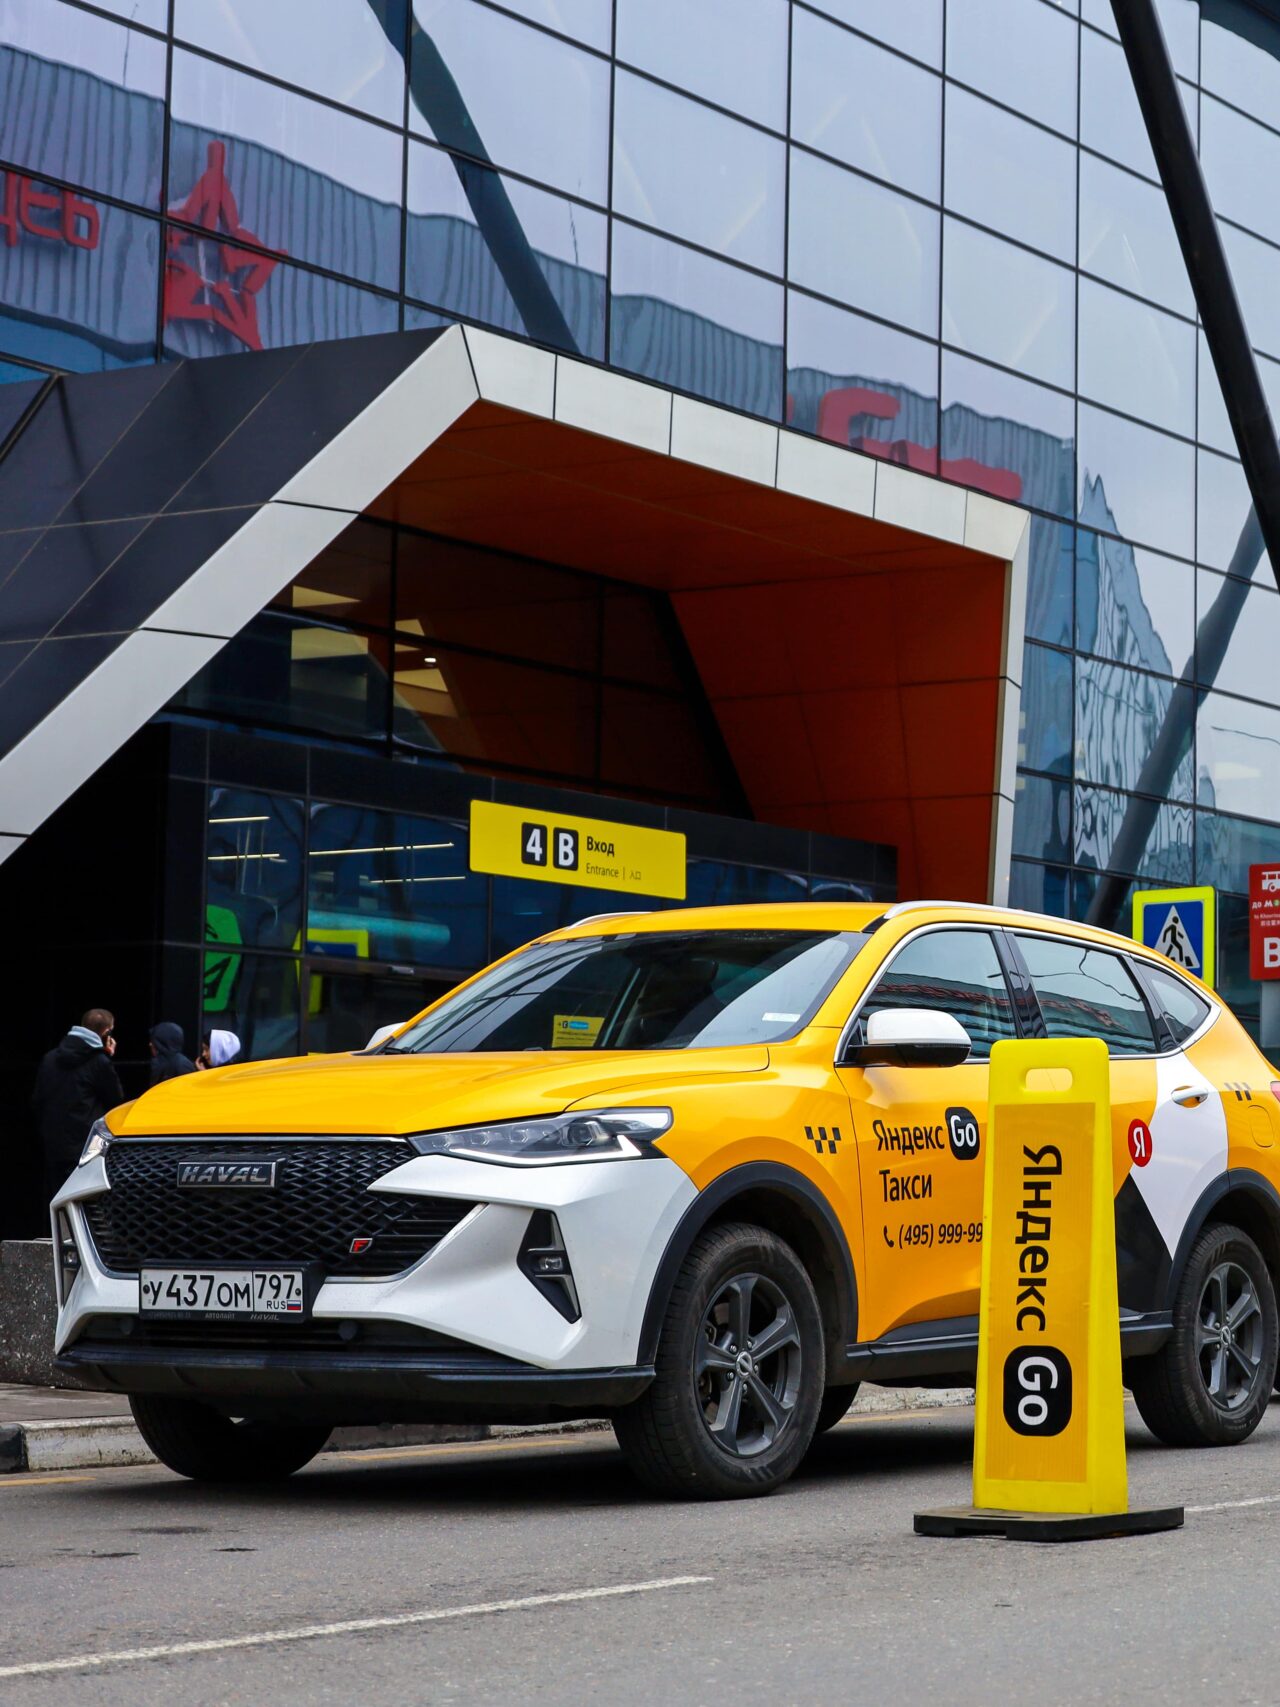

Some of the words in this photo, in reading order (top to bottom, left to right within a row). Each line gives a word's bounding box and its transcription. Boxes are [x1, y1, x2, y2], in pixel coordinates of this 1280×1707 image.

[525, 828, 543, 862] 4
[586, 835, 615, 857] Вход
[586, 863, 619, 878] Entrance
[1252, 901, 1262, 909] до
[872, 1119, 945, 1155] Яндекс
[950, 1114, 977, 1147] Go
[1133, 1126, 1146, 1158] Я
[181, 1166, 268, 1182] HAVAL
[879, 1169, 932, 1202] Такси
[899, 1223, 934, 1249] (495)
[1015, 1144, 1062, 1331] Яндекс
[149, 1274, 251, 1308] У437ОМ
[255, 1274, 296, 1300] 797
[266, 1300, 287, 1310] RUS
[1017, 1356, 1059, 1426] Go
